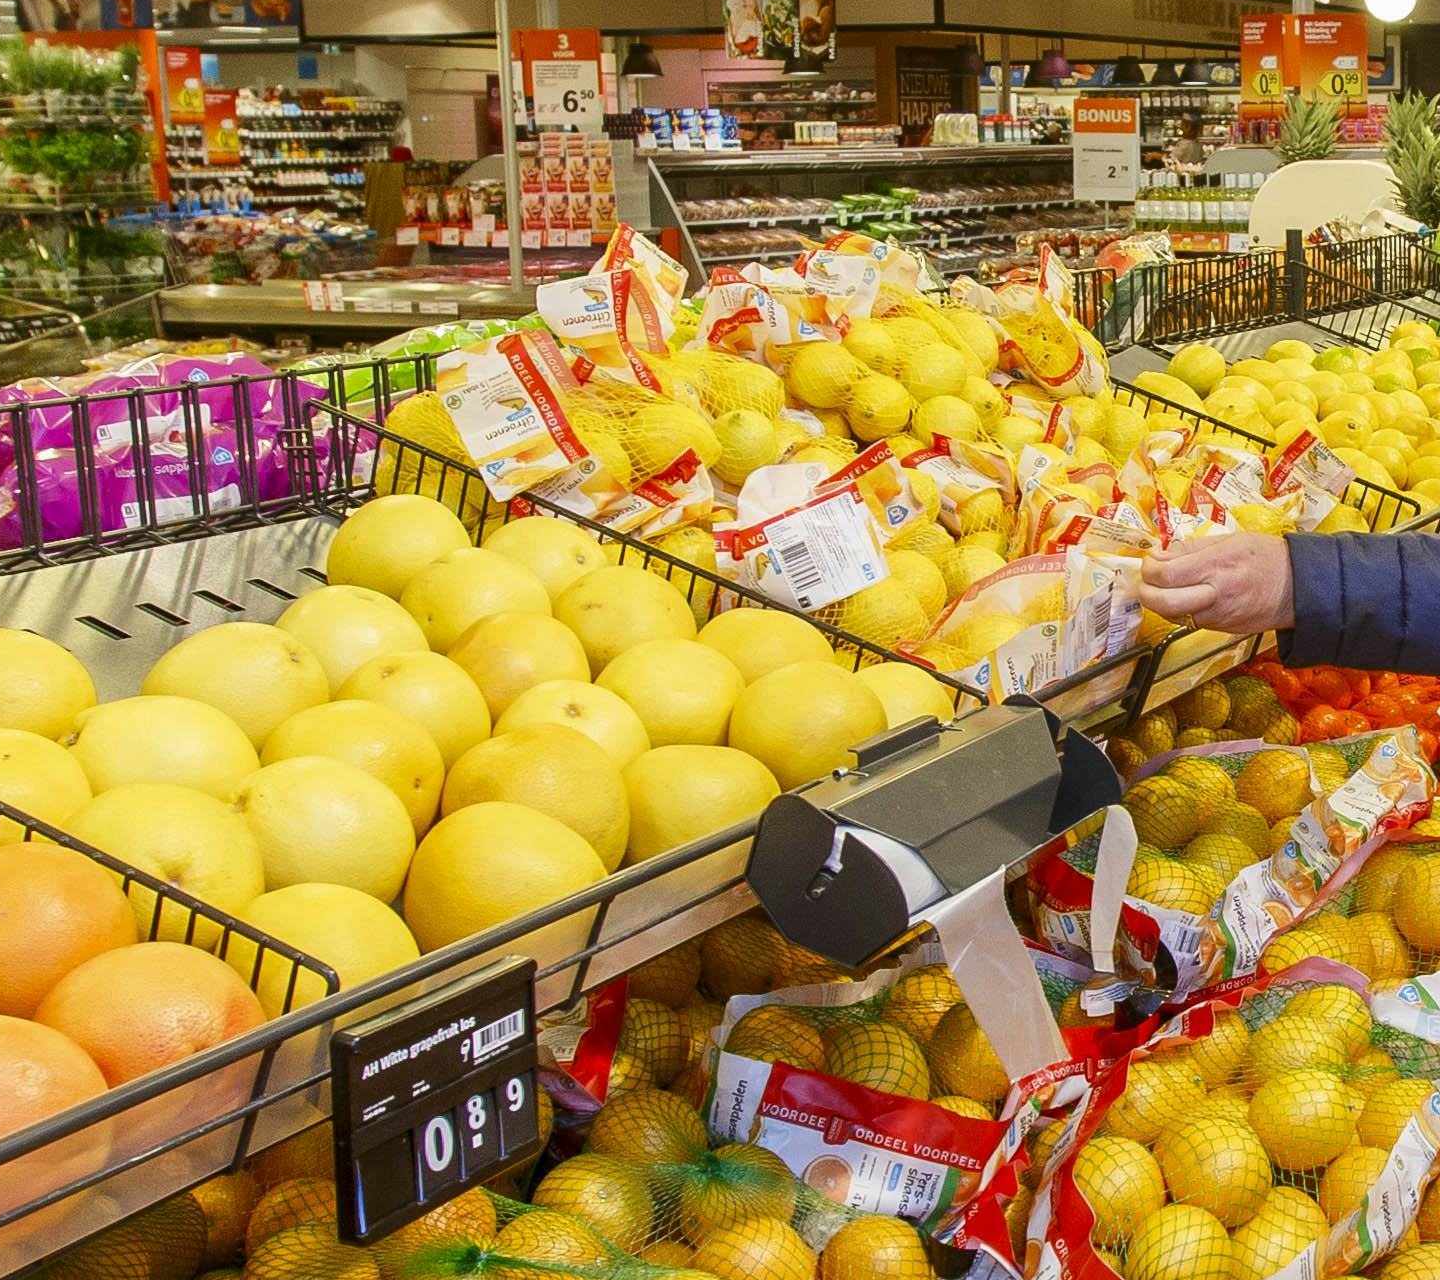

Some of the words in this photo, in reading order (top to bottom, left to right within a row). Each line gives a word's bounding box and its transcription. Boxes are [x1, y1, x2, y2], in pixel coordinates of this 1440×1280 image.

[552, 50, 576, 58] VOOR
[557, 34, 569, 50] 3
[900, 73, 952, 95] NIEUWE
[1077, 108, 1131, 123] BONUS
[562, 310, 612, 328] Citroenen
[509, 354, 535, 389] RDEEL
[534, 389, 567, 448] VOORDEEL
[484, 413, 537, 442] Citroenen
[362, 1061, 379, 1080] AH
[380, 1049, 409, 1070] Witte
[409, 1023, 460, 1058] grapefruit
[459, 1016, 477, 1032] los
[760, 1102, 827, 1130] VOORDEE
[854, 1126, 910, 1154] ORDEEL
[912, 1142, 983, 1171] VOORDEEL
[913, 1171, 934, 1206] Pers-
